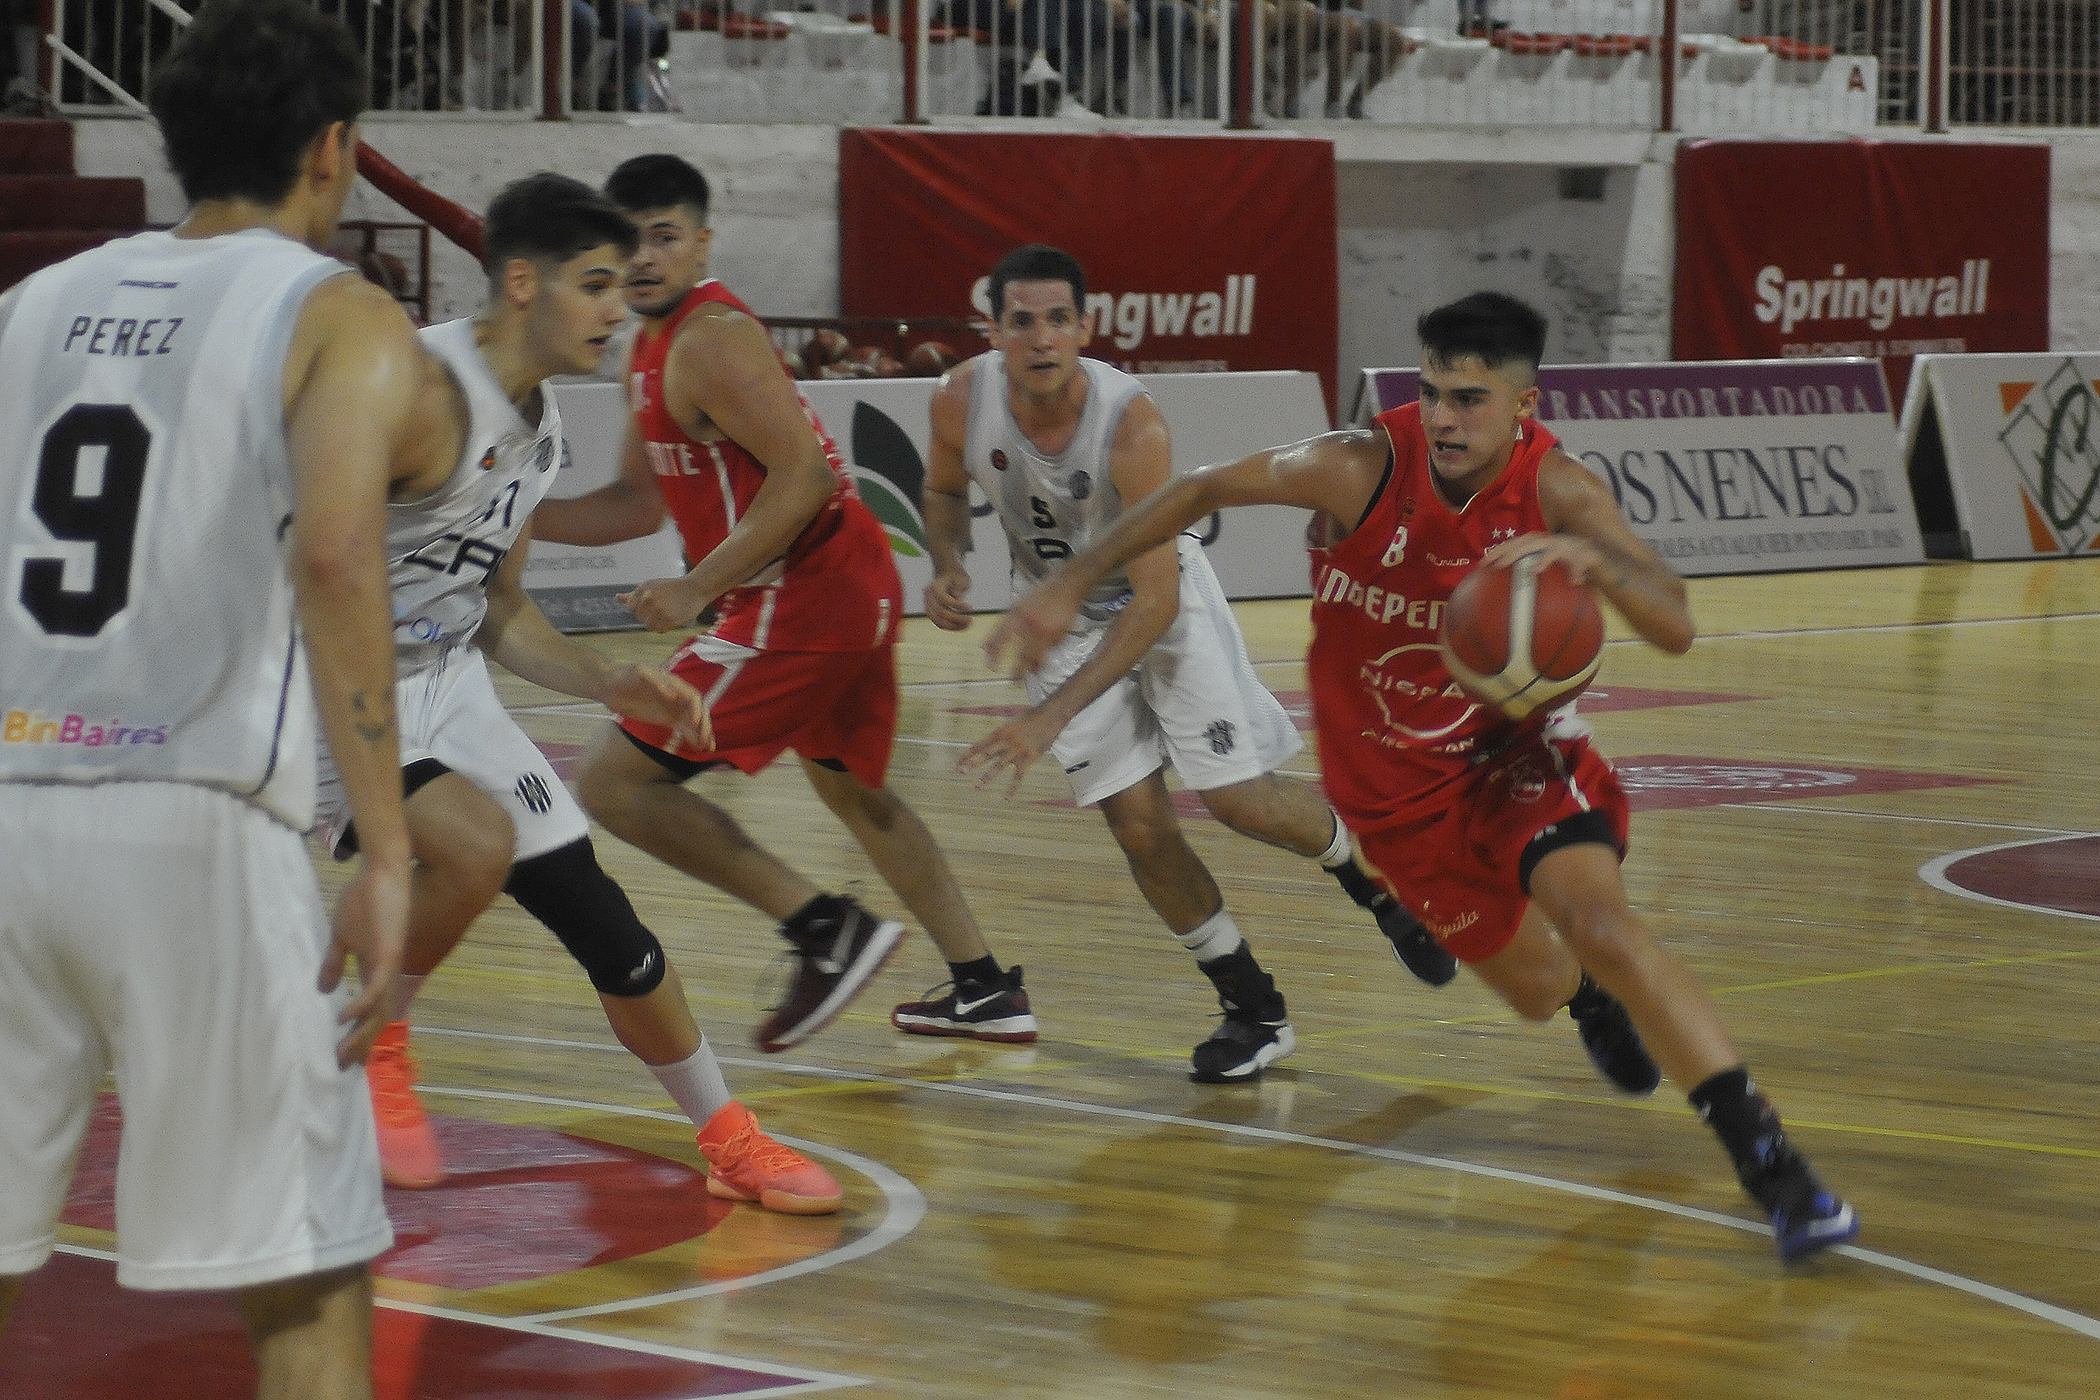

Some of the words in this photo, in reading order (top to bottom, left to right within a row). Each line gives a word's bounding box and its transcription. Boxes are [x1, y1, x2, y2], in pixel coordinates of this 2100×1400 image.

[1847, 64, 1866, 92] A
[1754, 258, 1990, 334] Springwall
[63, 315, 185, 357] PEREZ
[19, 403, 152, 637] 9
[1381, 526, 1408, 568] 8
